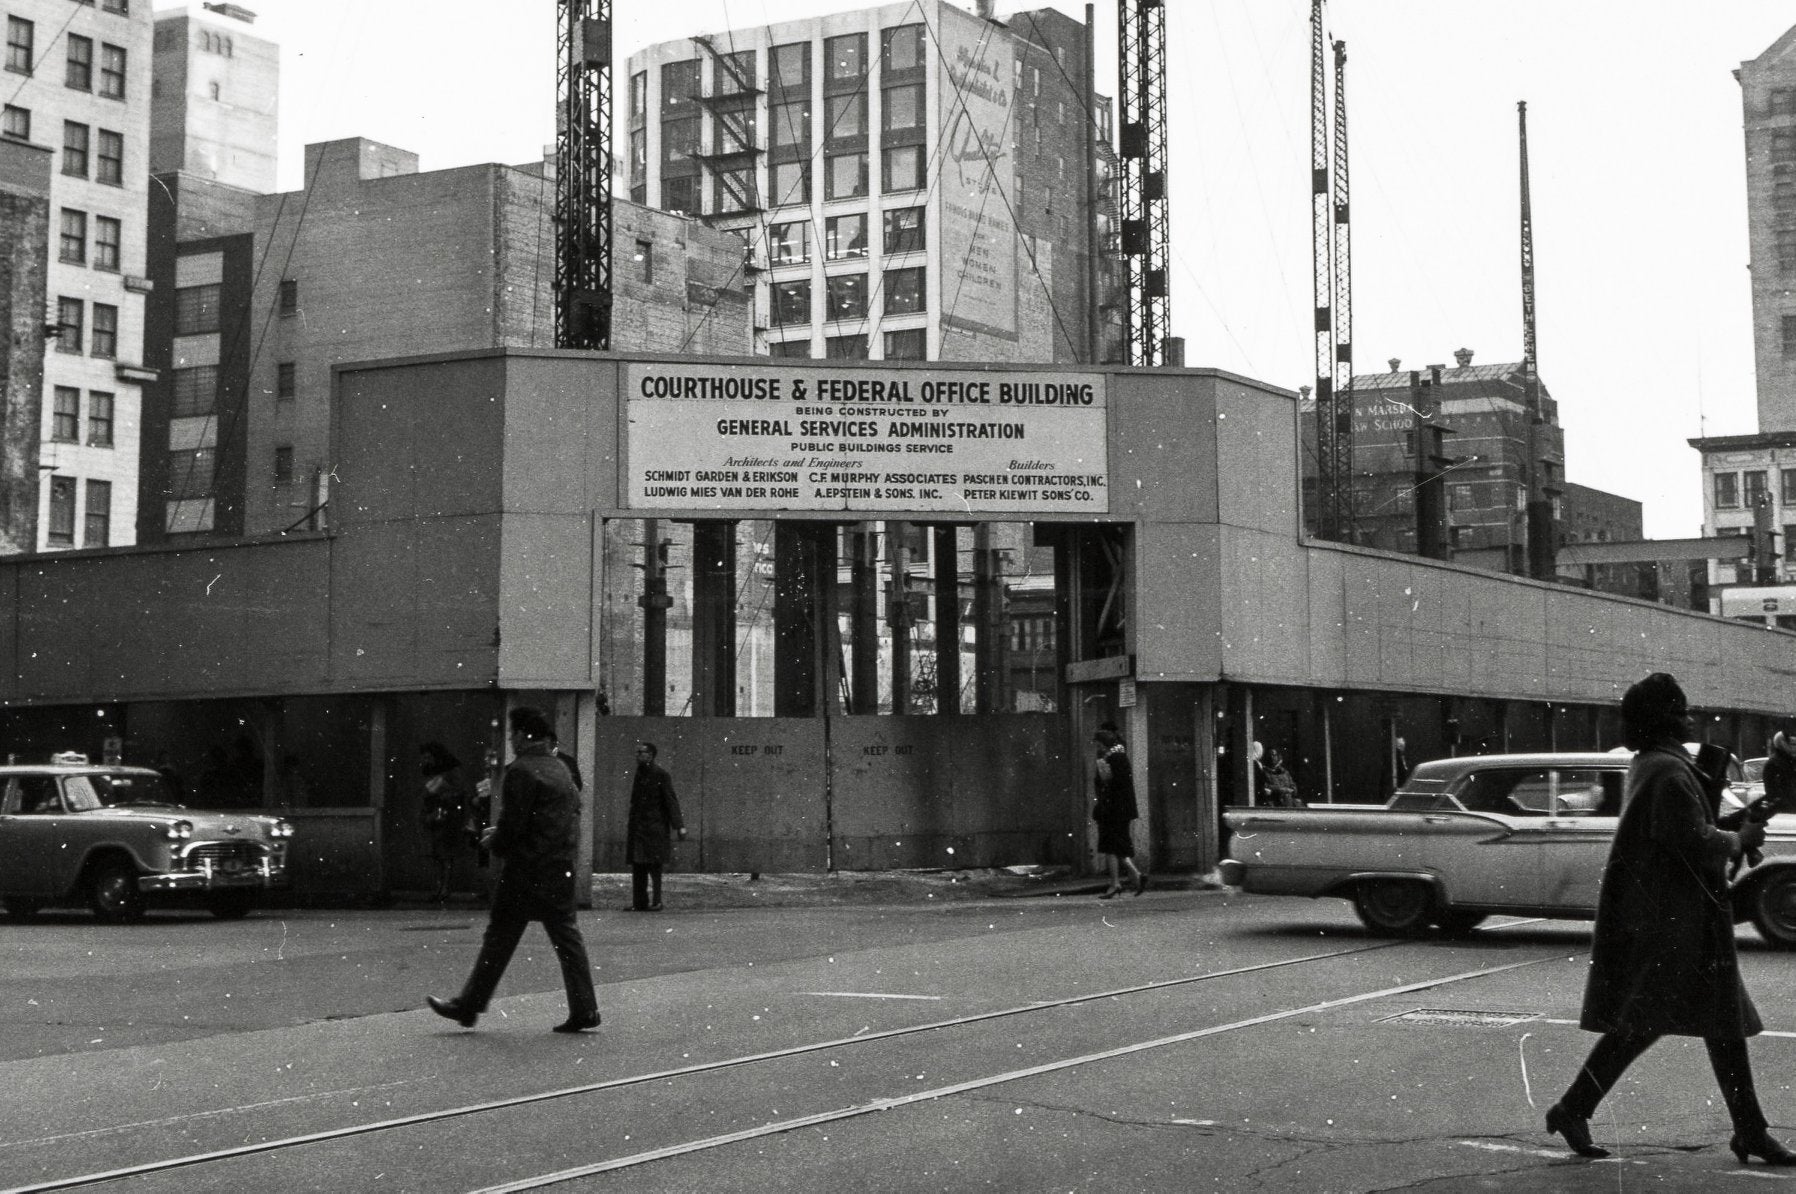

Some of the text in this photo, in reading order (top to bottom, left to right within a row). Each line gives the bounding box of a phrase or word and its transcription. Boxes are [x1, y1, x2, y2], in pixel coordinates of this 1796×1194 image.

[970, 245, 990, 260] MEN
[962, 257, 997, 276] WOMEN
[641, 376, 1094, 405] COURTHOUSE & FEDERAL OFFICE BUILDING
[796, 406, 950, 417] BEING CONSTRUCTED BY
[717, 420, 1025, 439] GENERAL SERVICES ADMINISTRATION
[1374, 418, 1412, 431] SCHOO
[791, 443, 954, 454] PUBLIC BUILDINGS SERVICE
[722, 456, 863, 470] Architects and Engineers
[1008, 460, 1056, 471] Builders
[644, 470, 798, 482] SCHMIDT GARDEN & ERIKSON
[830, 473, 880, 484] MURPHY
[884, 474, 958, 484] ASSOCIATES
[964, 474, 1008, 485] PASCHEN
[644, 486, 799, 498] LUDWIG MIES VAN DER ROHE
[874, 488, 882, 498] &
[919, 489, 943, 500] INC.
[964, 490, 996, 500] PETER
[999, 490, 1038, 500] KIEWIT
[732, 746, 784, 756] KEEP OUT
[864, 745, 914, 756] KEEP OUT
